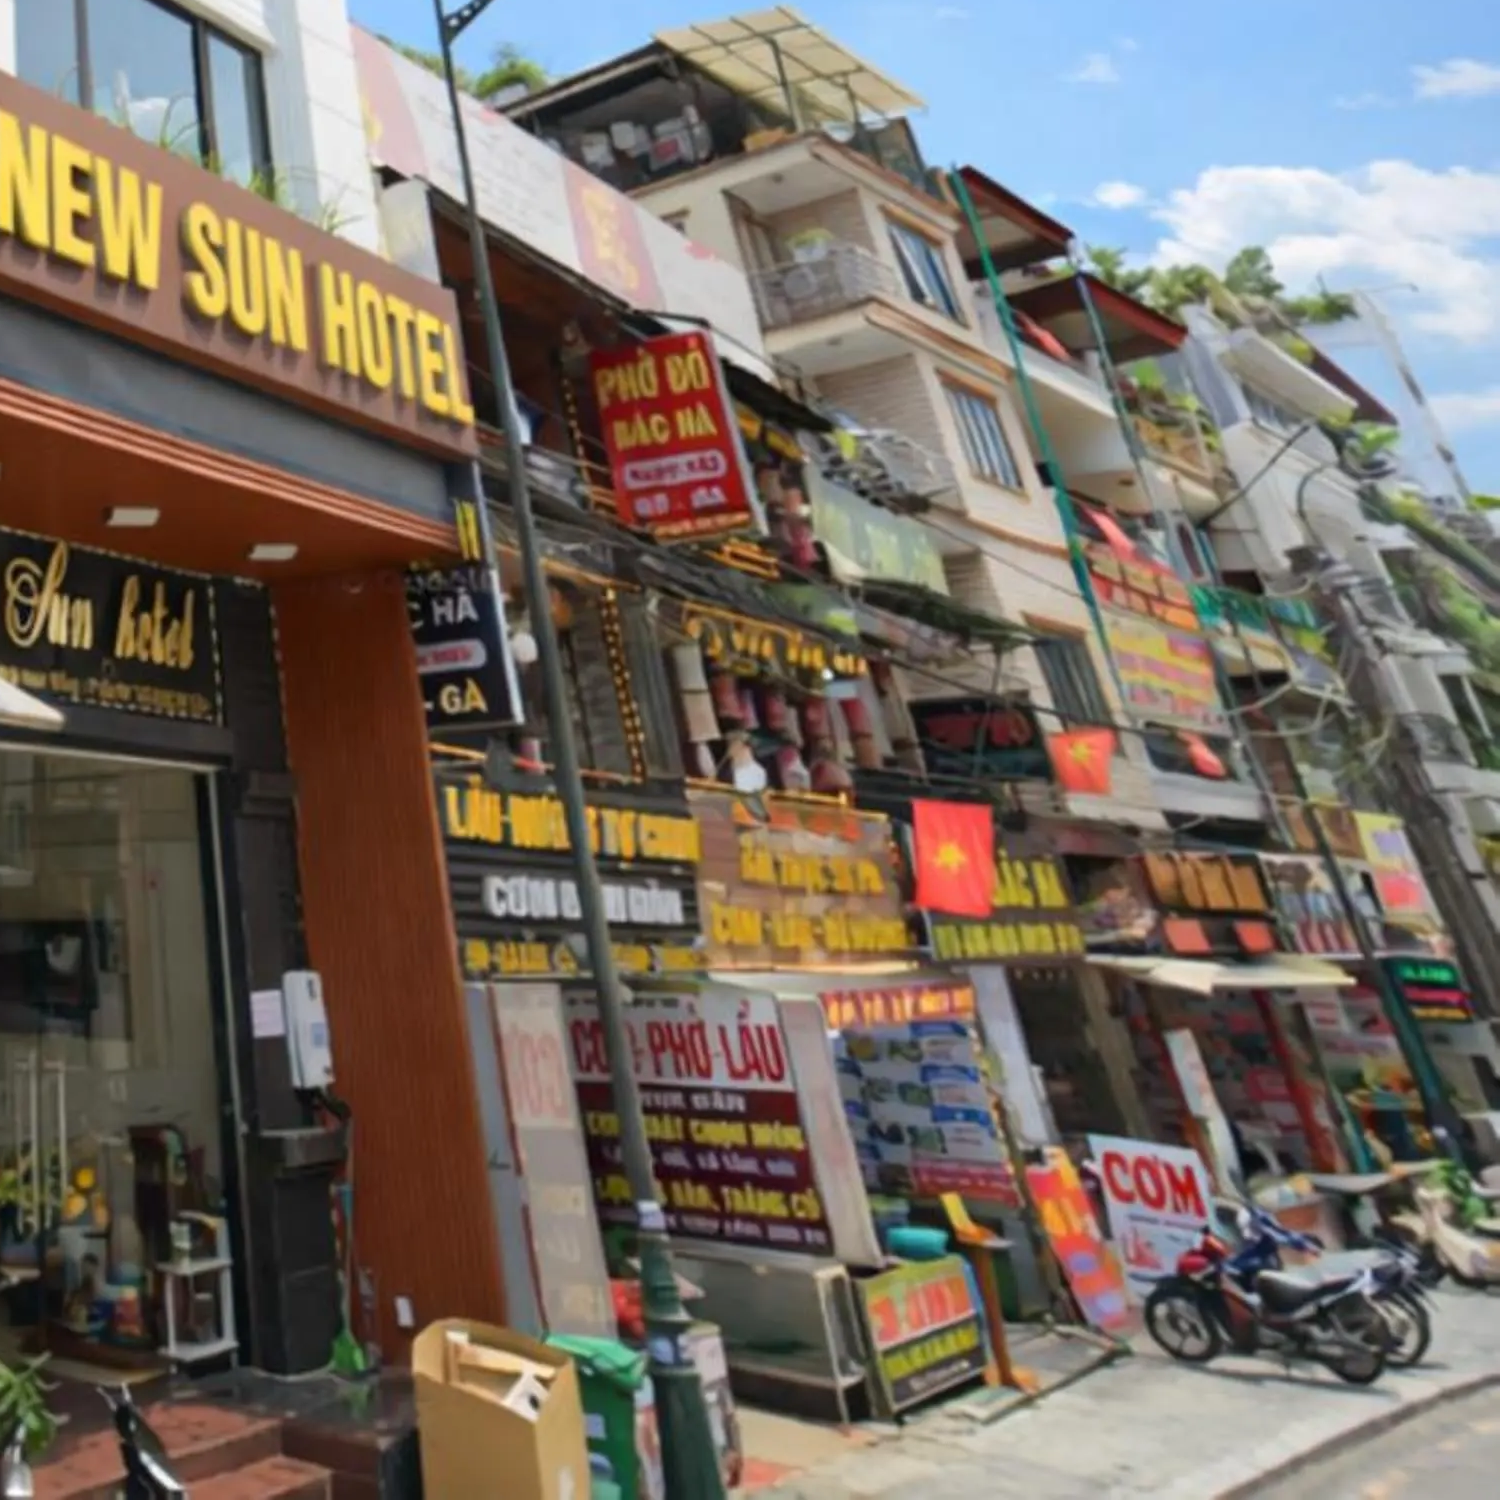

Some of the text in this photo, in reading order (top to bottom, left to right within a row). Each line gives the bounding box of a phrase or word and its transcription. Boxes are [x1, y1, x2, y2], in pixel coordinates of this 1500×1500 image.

[182, 200, 308, 352] SUN
[320, 261, 475, 426] HOTEL
[647, 1001, 713, 1080] PHỞ
[718, 998, 786, 1083] LẨU
